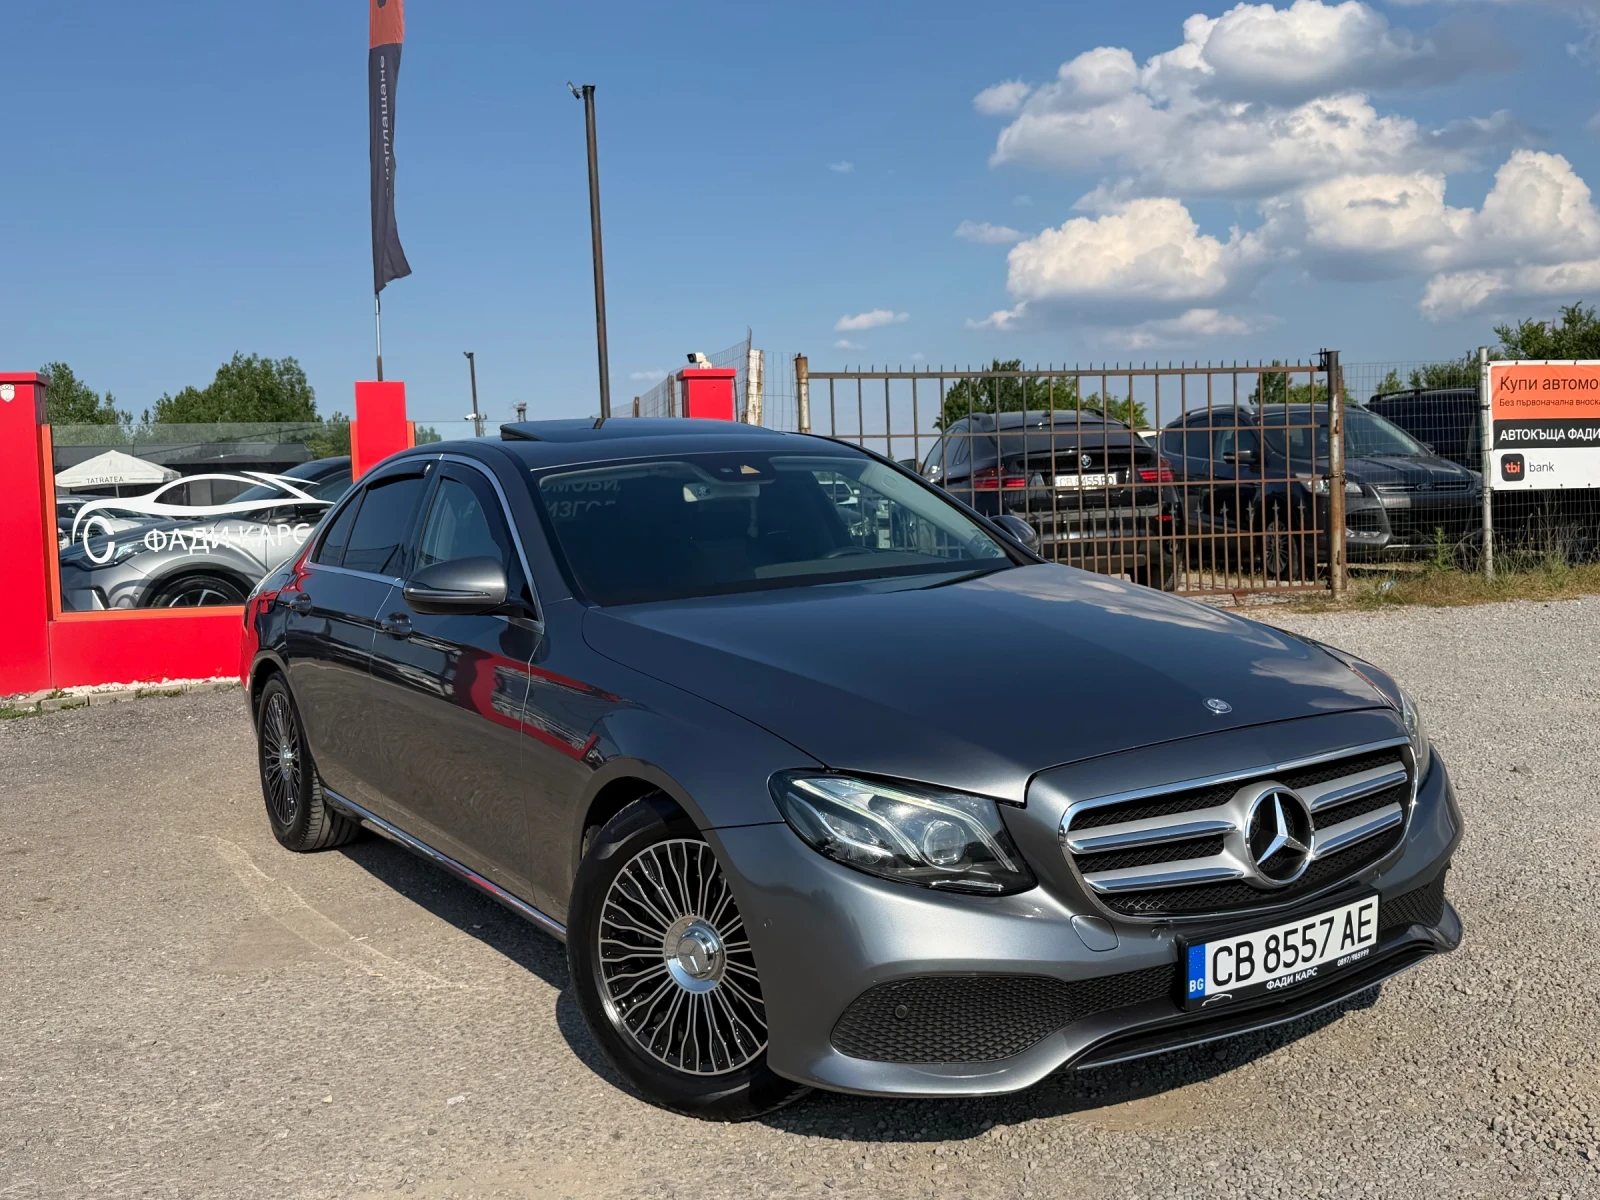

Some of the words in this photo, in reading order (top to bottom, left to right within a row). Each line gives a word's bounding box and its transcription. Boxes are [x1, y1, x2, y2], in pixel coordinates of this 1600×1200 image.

[1500, 376, 1538, 394] Купи
[1542, 377, 1600, 391] автомо
[1499, 398, 1515, 407] Без
[1516, 399, 1574, 408] първоначална
[1500, 429, 1566, 442] АВТОКЪЩА
[1567, 428, 1600, 441] ФАДИ
[1505, 461, 1521, 474] tbi
[1529, 461, 1555, 473] bank
[86, 476, 125, 484] TATRATEA
[144, 526, 230, 555] ФАДИ
[240, 523, 311, 548] КАРС
[1212, 940, 1255, 987] CB
[1263, 916, 1335, 974] 8557
[1340, 903, 1373, 951] AE
[1189, 978, 1204, 993] BG
[1266, 974, 1295, 990] ФАДИ
[1295, 967, 1318, 982] КАРС
